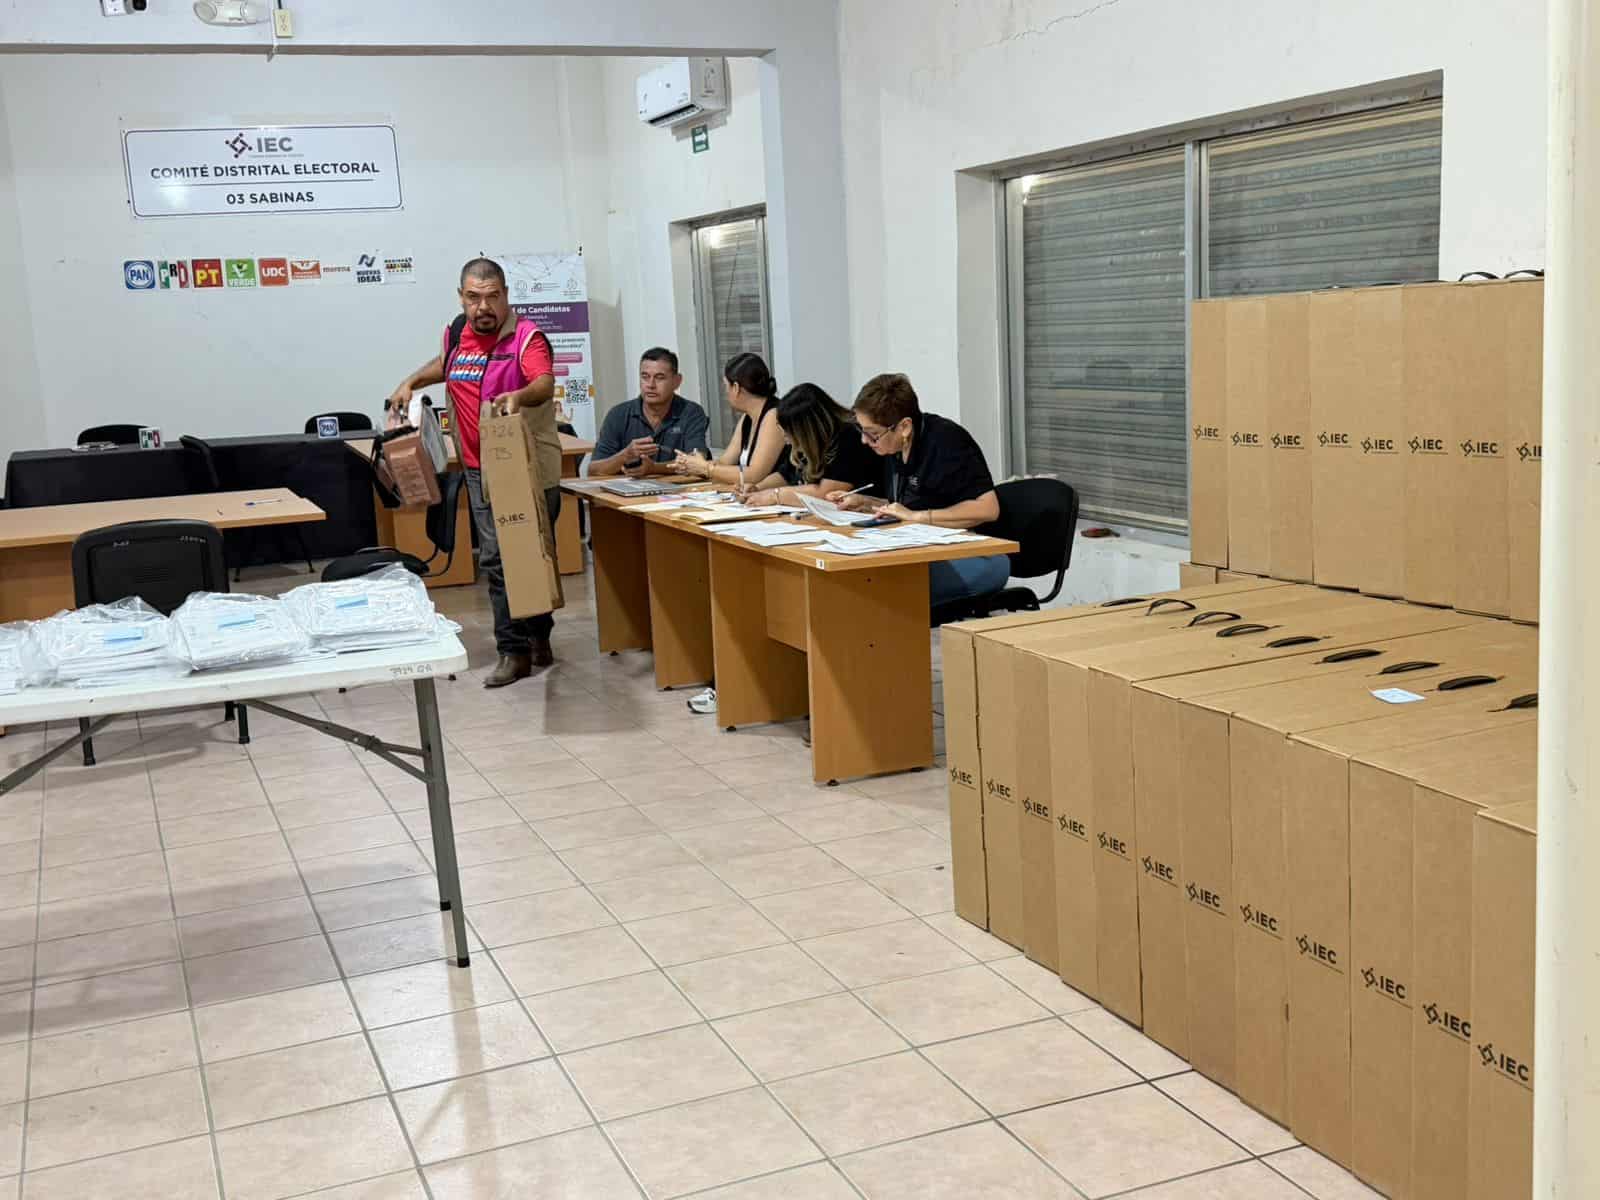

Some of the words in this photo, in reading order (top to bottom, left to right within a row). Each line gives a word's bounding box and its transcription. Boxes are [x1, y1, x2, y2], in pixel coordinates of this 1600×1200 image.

[256, 137, 293, 153] IEC
[150, 163, 209, 179] COMITÉ
[213, 163, 290, 177] DISTRITAL
[294, 162, 380, 175] ELECTORAL
[226, 193, 246, 205] 03
[249, 191, 314, 205] SABINAS
[130, 270, 149, 281] PAN
[196, 269, 219, 285] PT
[262, 267, 286, 277] UDC
[229, 279, 256, 287] VERDE
[517, 306, 527, 314] de
[528, 304, 571, 314] Candidatas
[1204, 427, 1219, 437] IEC
[1242, 434, 1259, 444] IEC
[1330, 433, 1349, 444] IEC
[1283, 435, 1300, 446] IEC
[1374, 439, 1394, 450] IEC
[1423, 439, 1443, 450] IEC
[1476, 442, 1498, 454] IEC
[509, 513, 525, 522] IEC
[958, 770, 972, 785] IEC
[996, 784, 1011, 798] IEC
[1033, 802, 1049, 817] IEC
[1069, 820, 1085, 836] IEC
[1109, 837, 1126, 854] IEC
[1154, 862, 1173, 880] IEC
[1200, 889, 1220, 908] IEC
[1256, 911, 1277, 931] IEC
[1313, 942, 1337, 964] IEC
[1380, 976, 1406, 999] IEC
[1443, 1012, 1471, 1038] IEC
[1500, 1054, 1529, 1082] IEC
